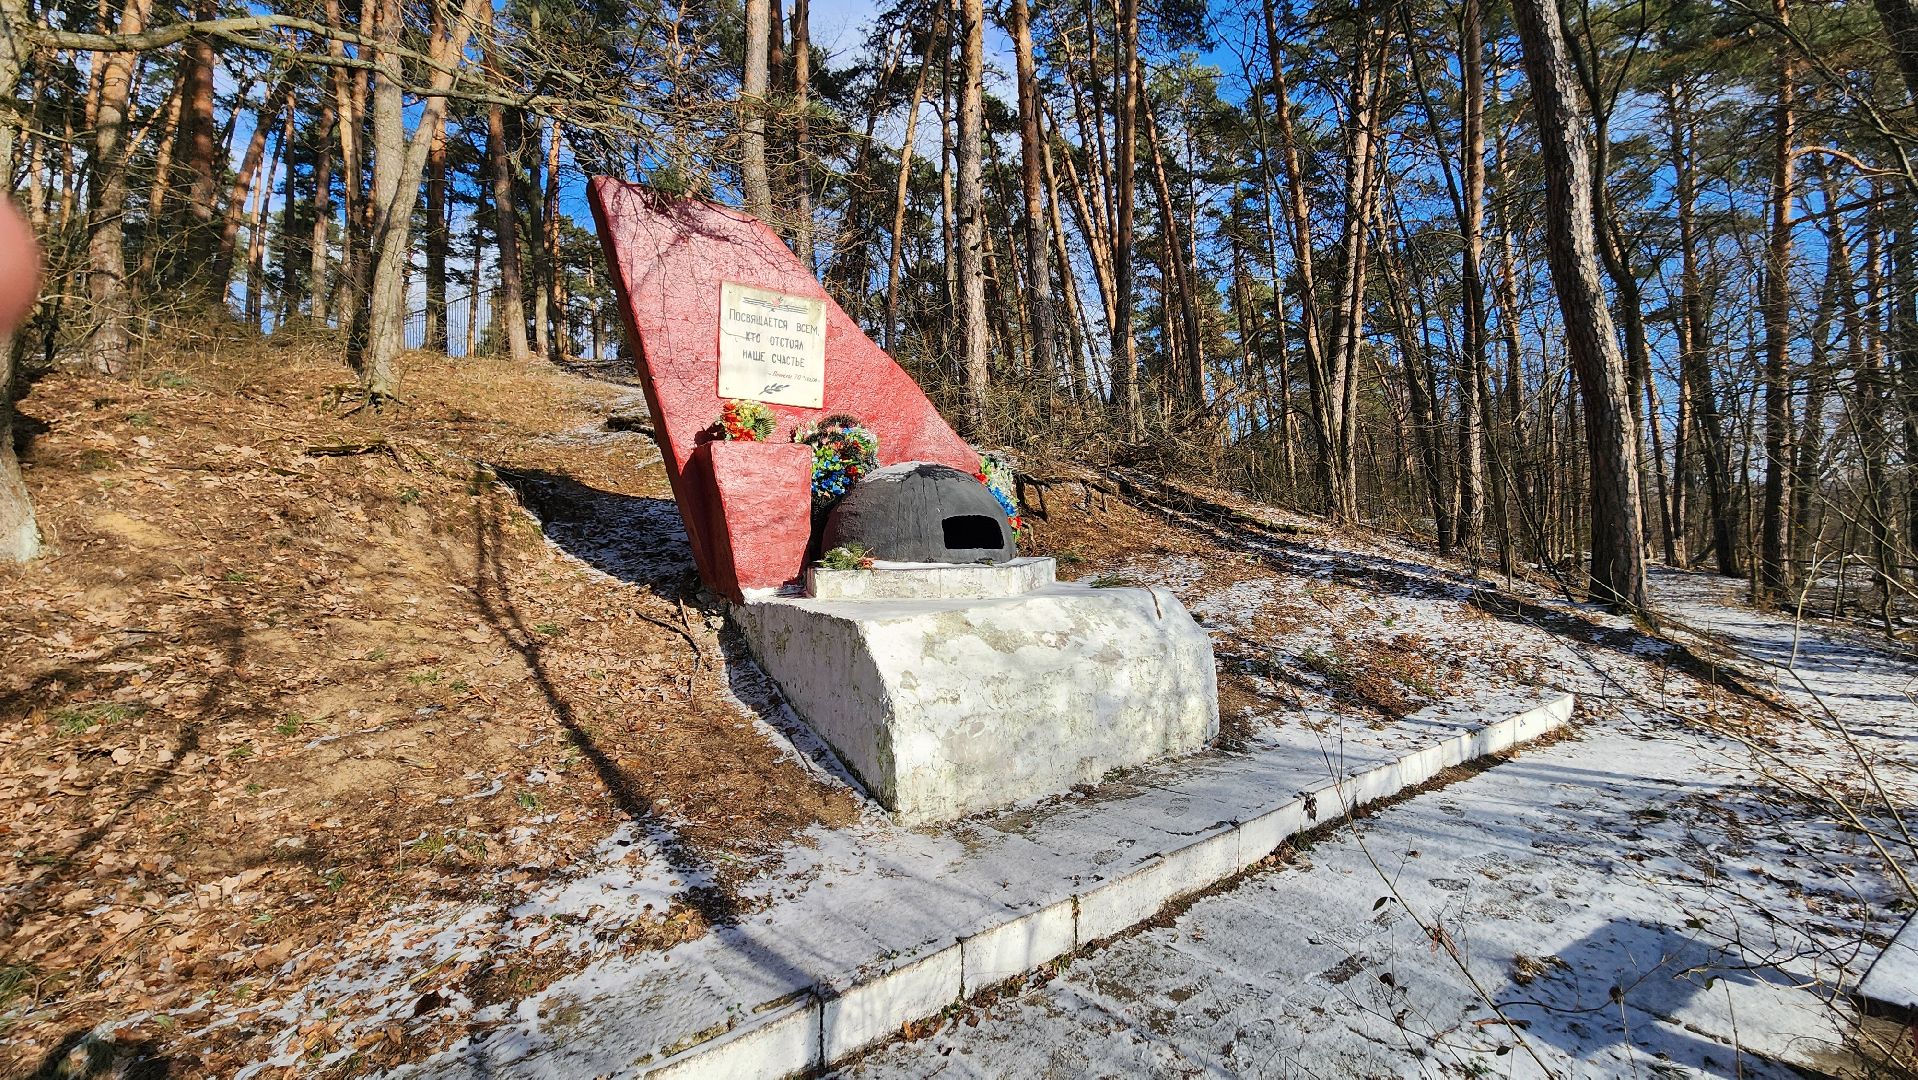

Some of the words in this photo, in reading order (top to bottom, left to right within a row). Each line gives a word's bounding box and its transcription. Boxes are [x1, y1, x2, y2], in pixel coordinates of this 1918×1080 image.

[729, 308, 788, 331] ПОСВЯЩАЕТСЯ
[745, 331, 761, 343] КТО
[769, 337, 804, 351] ОТСТОЯЛ
[742, 350, 766, 362] НАШЕ
[771, 353, 805, 368] СЧАСТЬЕ
